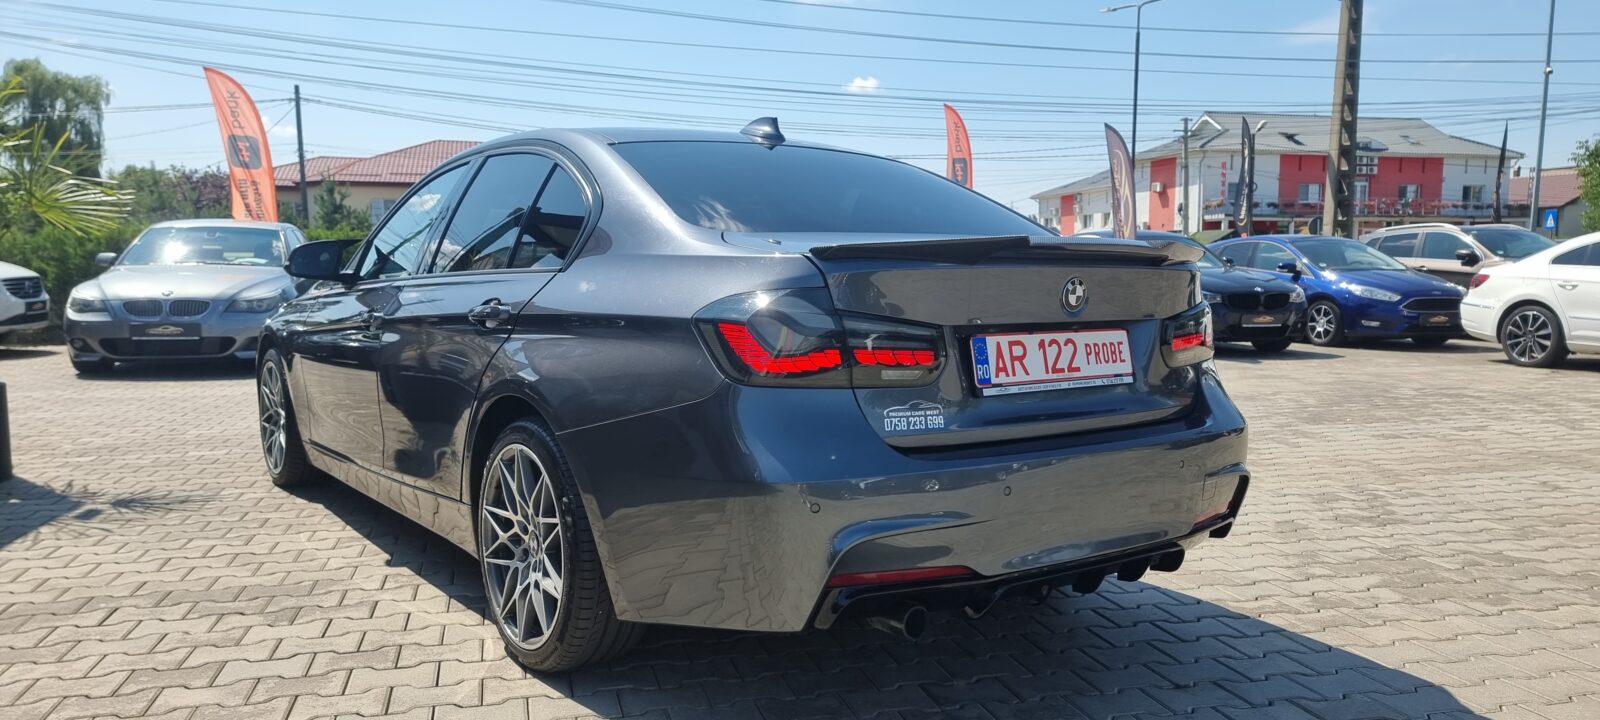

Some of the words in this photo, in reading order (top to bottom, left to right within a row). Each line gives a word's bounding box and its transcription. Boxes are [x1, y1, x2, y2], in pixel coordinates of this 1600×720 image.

[994, 340, 1030, 378] AR
[1038, 337, 1081, 374] 122
[1084, 341, 1126, 366] PROBE
[977, 364, 990, 379] RO
[884, 417, 907, 431] 0758
[909, 416, 926, 430] 233
[927, 415, 945, 429] 699
